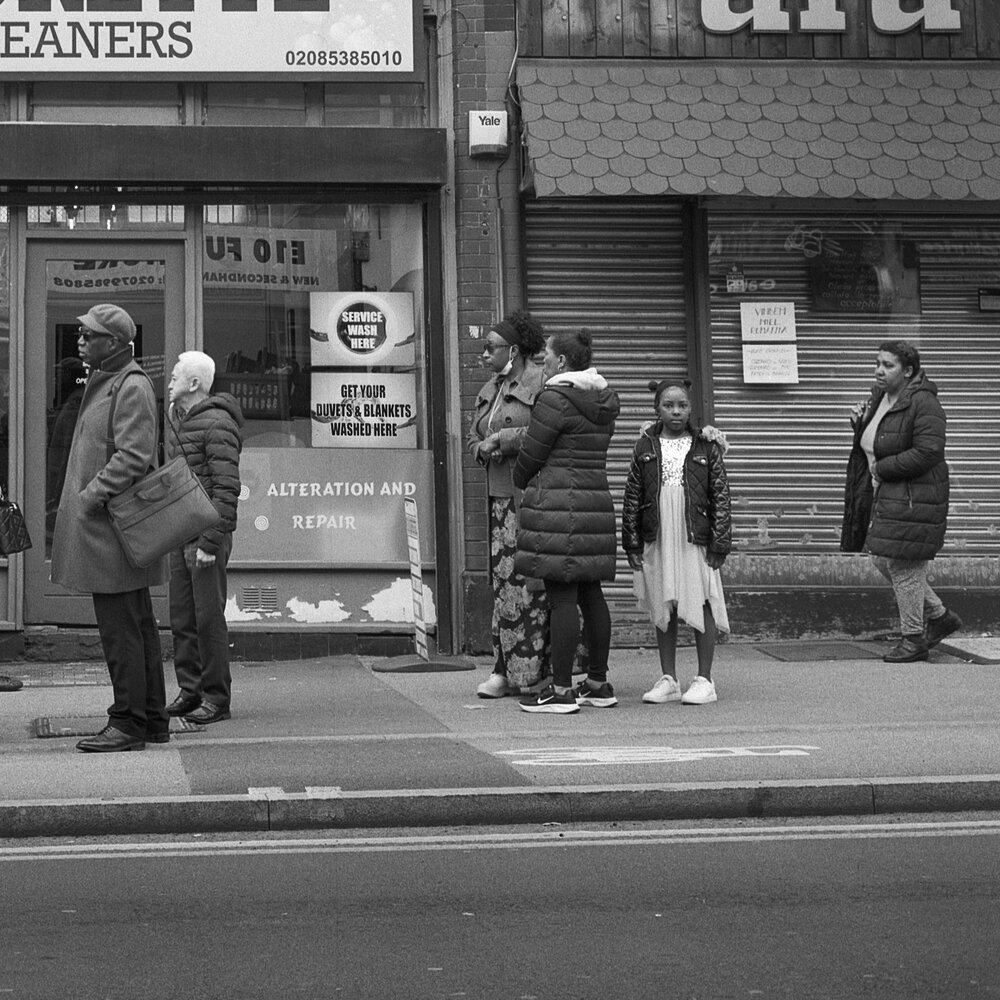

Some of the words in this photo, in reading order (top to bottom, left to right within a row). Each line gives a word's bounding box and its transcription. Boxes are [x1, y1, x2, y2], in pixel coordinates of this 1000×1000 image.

[285, 49, 403, 67] 02085385010
[478, 115, 501, 126] Yale
[341, 311, 383, 323] SERVICE
[347, 324, 378, 336] WASH
[350, 338, 376, 349] HERE
[340, 384, 359, 399] GET
[360, 384, 386, 399] YOUR
[316, 403, 353, 417] DUVETS
[354, 404, 362, 417] &
[363, 403, 412, 418] BLANKETS
[330, 422, 372, 436] WASHED
[373, 423, 398, 437] HERE
[267, 482, 375, 497] ALTERATION
[380, 481, 417, 496] AND
[291, 514, 357, 530] REPAIR
